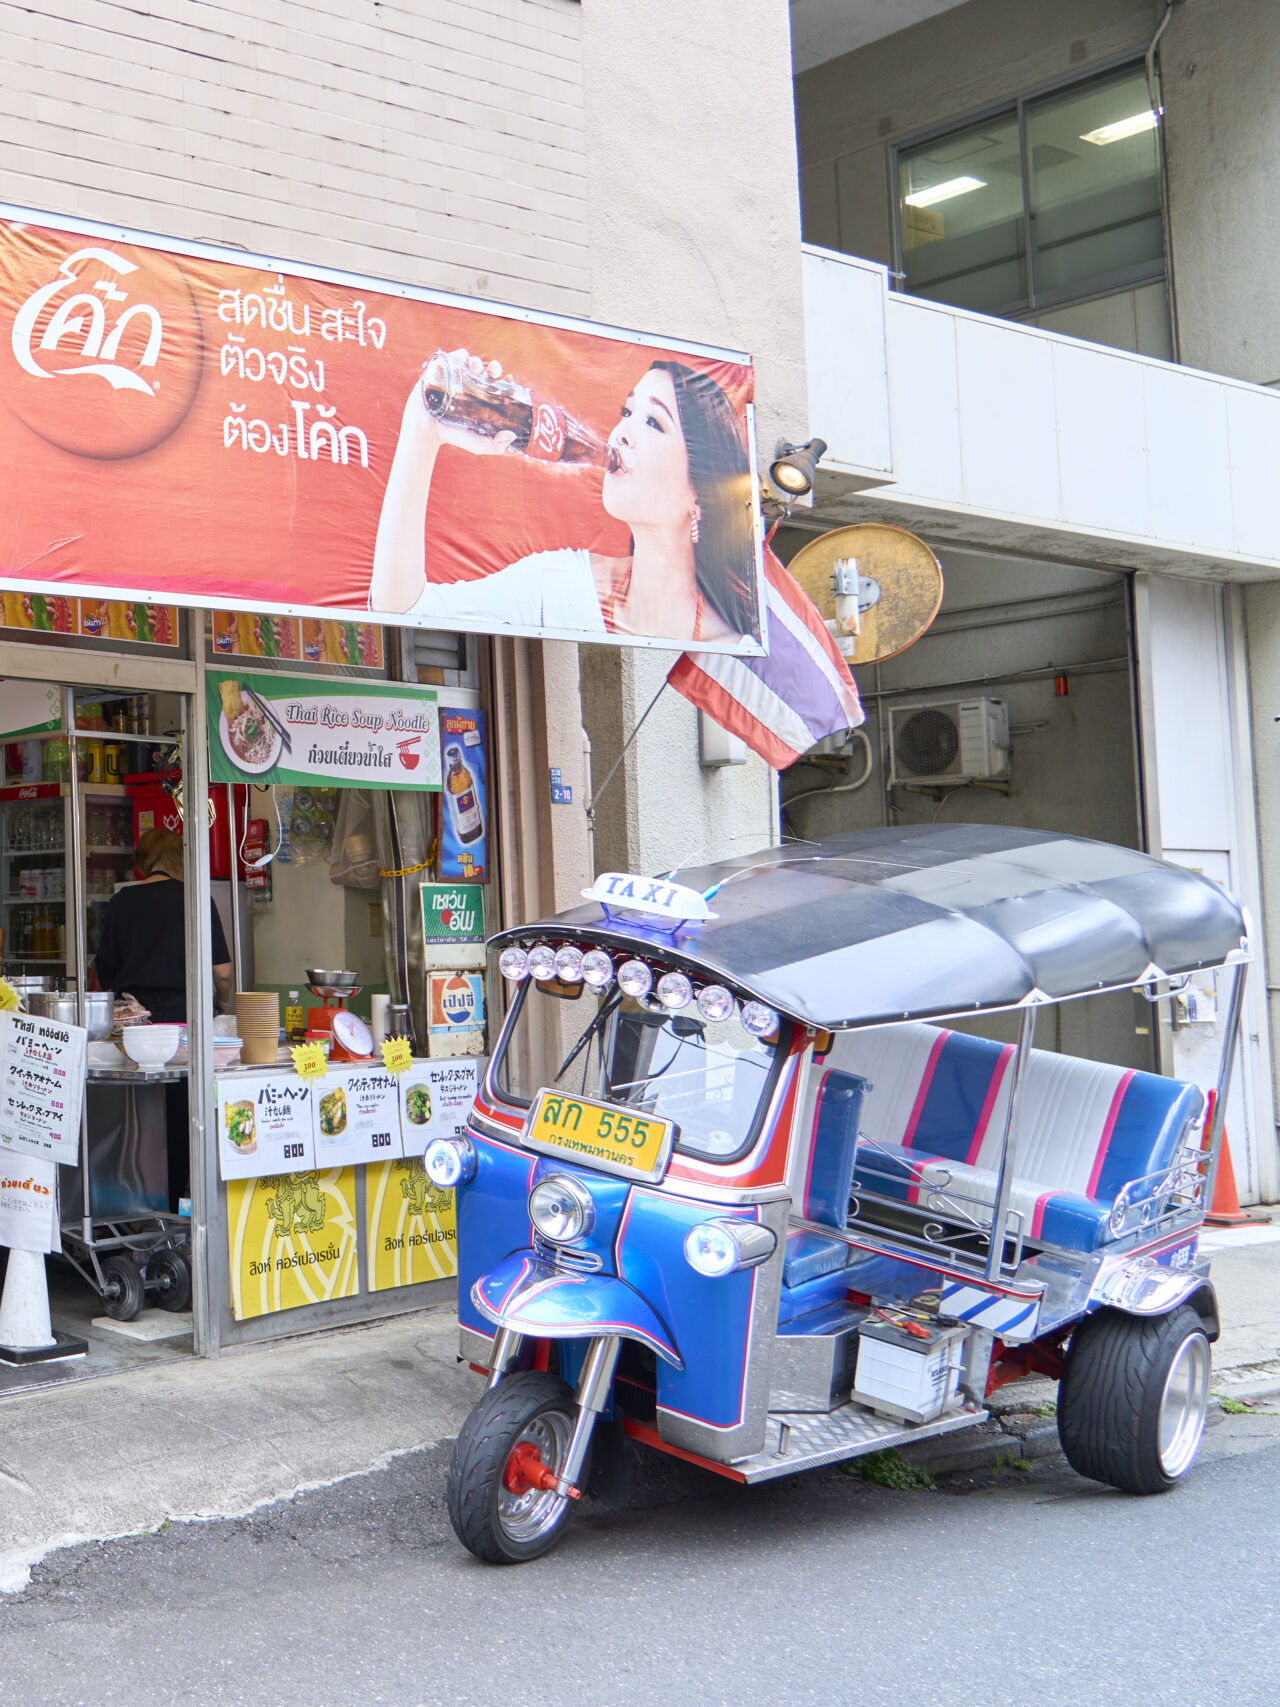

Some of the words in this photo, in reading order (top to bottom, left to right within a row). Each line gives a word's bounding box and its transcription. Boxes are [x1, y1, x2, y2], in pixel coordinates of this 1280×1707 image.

[217, 276, 311, 338] สดชื่น
[320, 300, 388, 350] สะใจ
[220, 333, 326, 393] ตัวจริง
[286, 702, 318, 724] Thai
[320, 705, 349, 728] Rice
[350, 707, 383, 732] Soup
[386, 709, 430, 732] Noodle
[554, 788, 571, 800] 2-10
[606, 876, 678, 907] TAXI
[303, 1061, 317, 1071] 300
[390, 1053, 403, 1065] 300
[544, 1097, 584, 1131] สก
[597, 1112, 650, 1148] 555
[284, 1143, 304, 1158] 800
[372, 1133, 391, 1147] 800
[548, 1133, 635, 1167] กรุงเทพมหานคร
[384, 1232, 405, 1251] สิงห์
[249, 1257, 272, 1276] สิงห์
[276, 1242, 341, 1271] คอร์เปอเรชั่น
